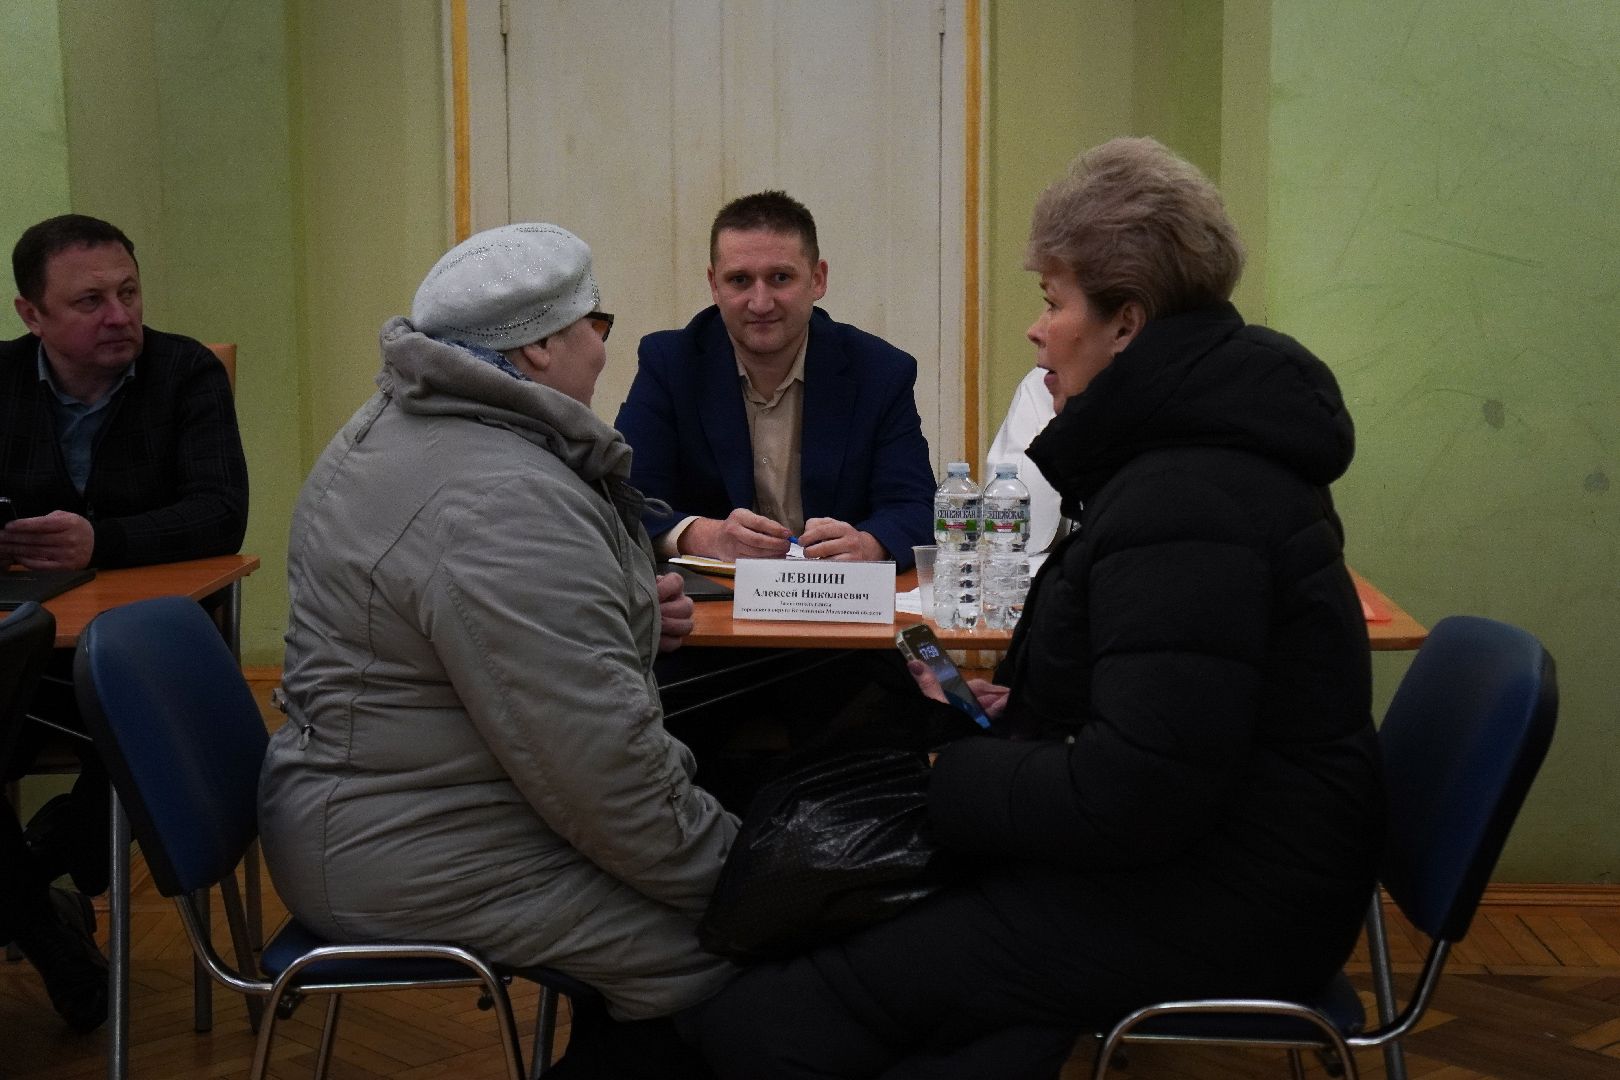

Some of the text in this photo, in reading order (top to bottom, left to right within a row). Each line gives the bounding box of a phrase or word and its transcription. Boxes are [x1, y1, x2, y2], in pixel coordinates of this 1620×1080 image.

[775, 572, 845, 585] ЛЕВШИН
[753, 588, 869, 600] Алексей Николаевич
